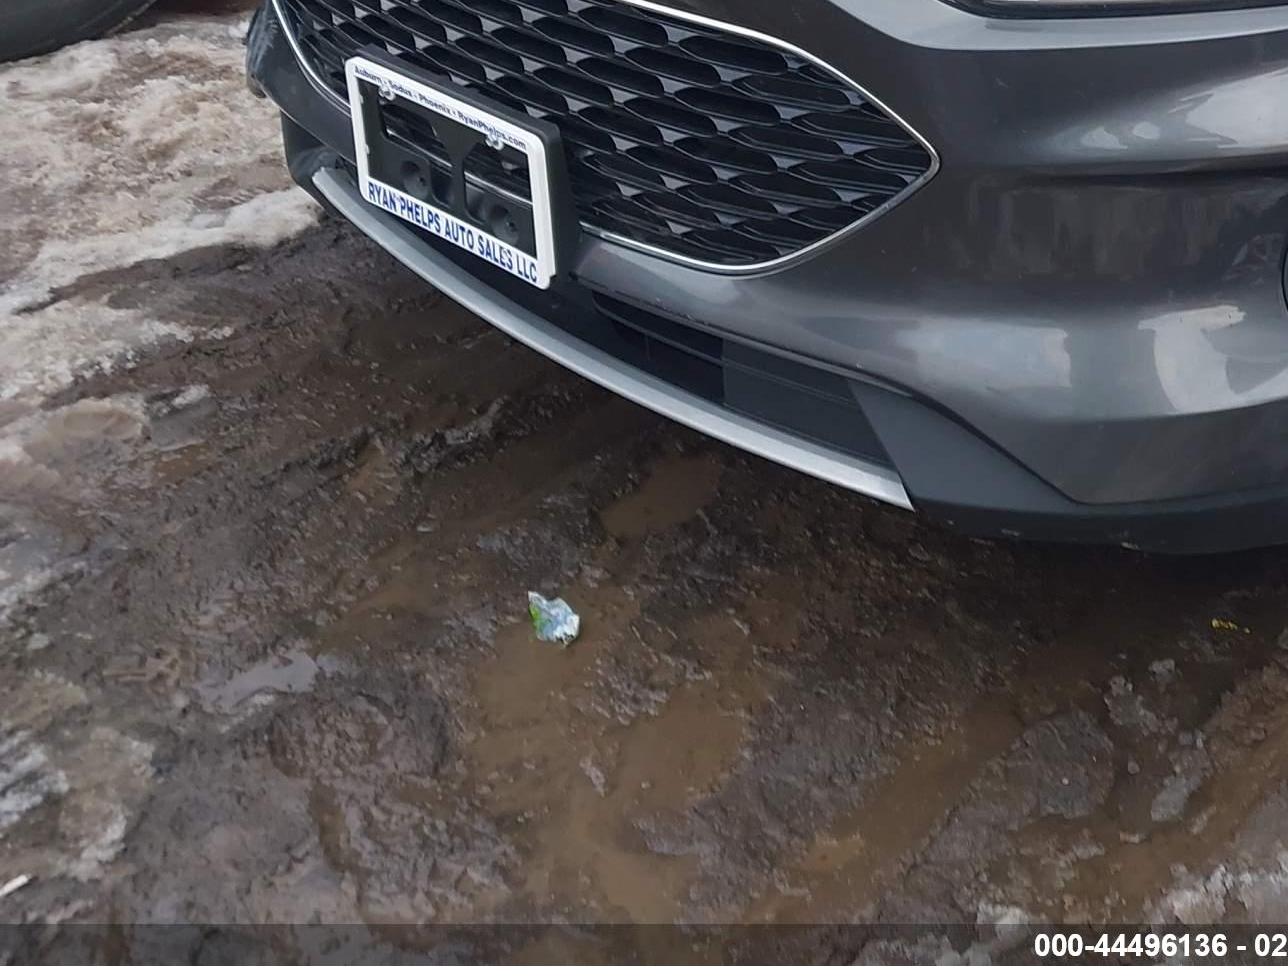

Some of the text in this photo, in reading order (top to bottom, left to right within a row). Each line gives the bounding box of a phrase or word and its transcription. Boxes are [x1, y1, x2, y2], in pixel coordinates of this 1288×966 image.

[354, 65, 383, 85] Auburn
[418, 92, 452, 115] Phoenix
[368, 181, 537, 283] RYAN PHELPS AUTO SALES LLC
